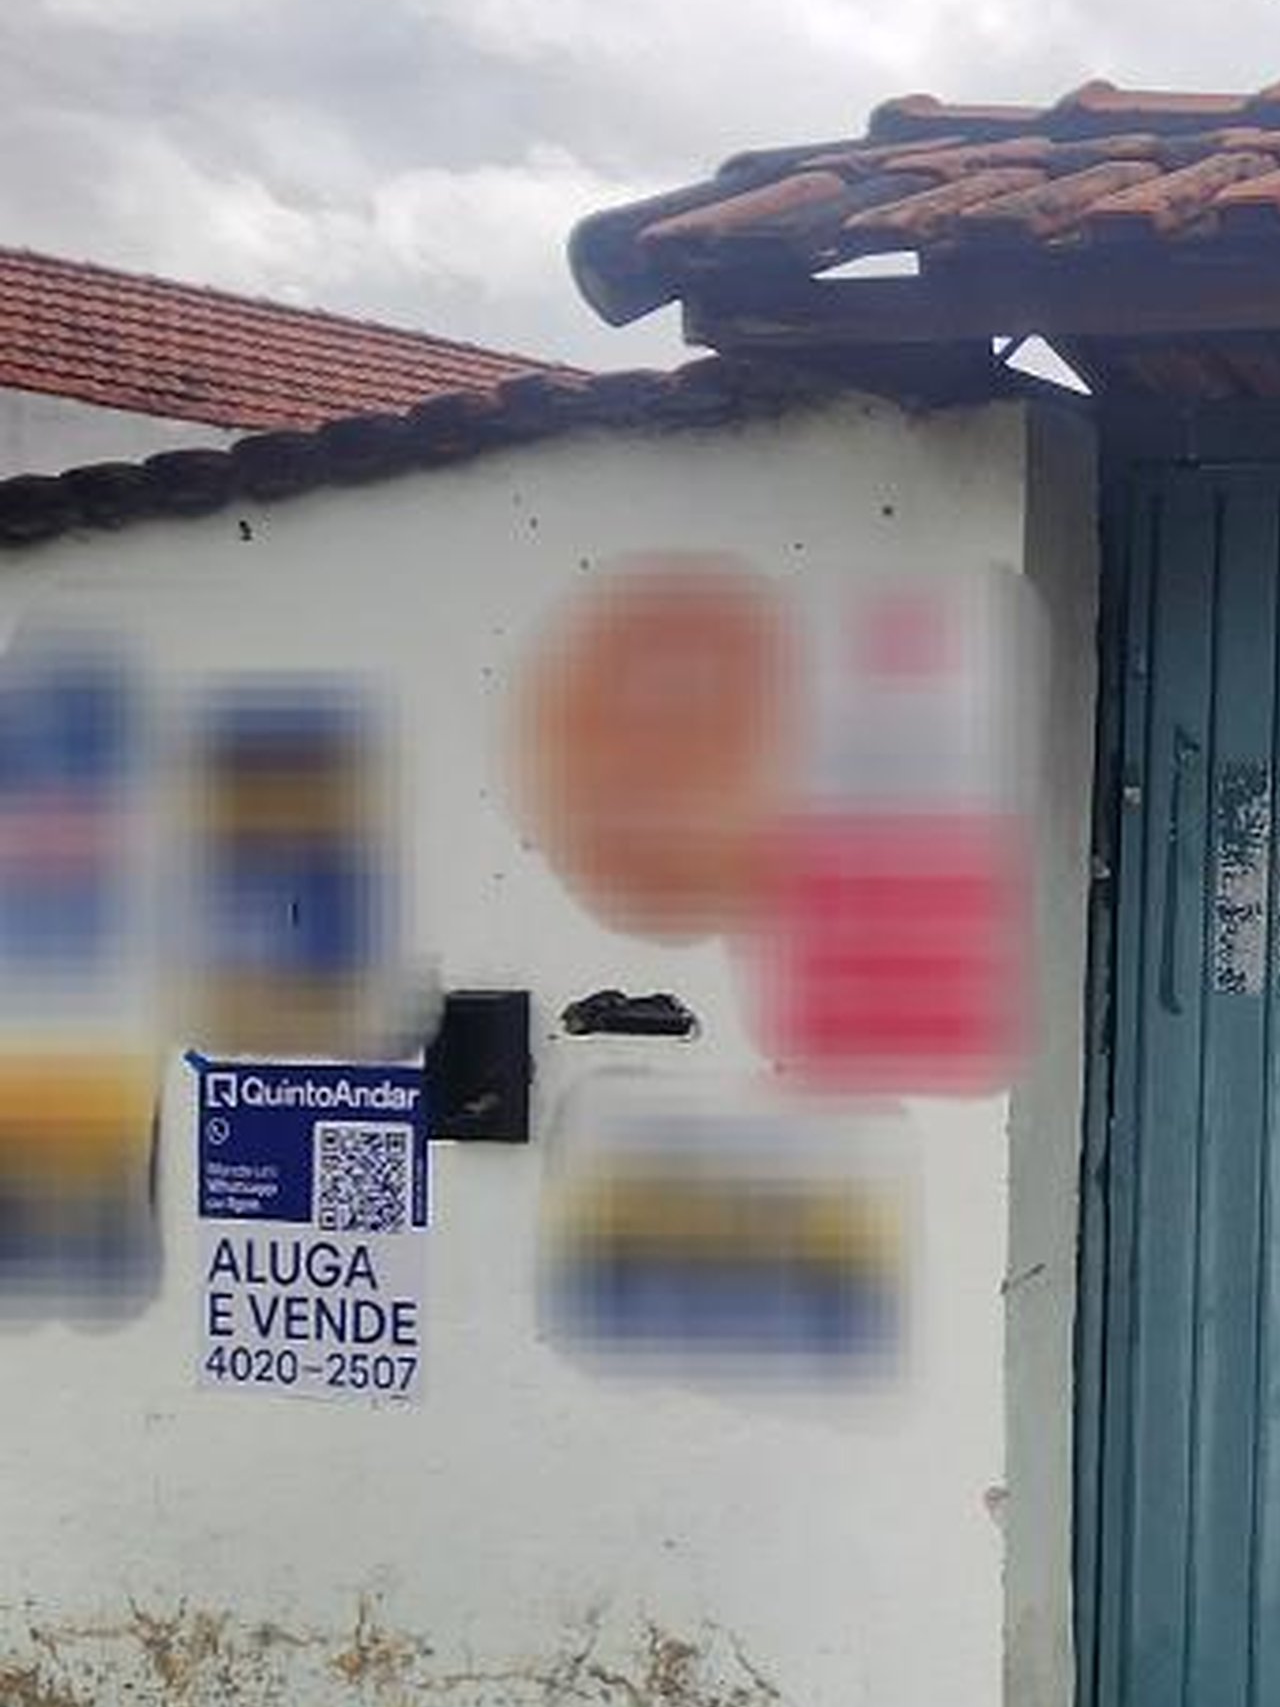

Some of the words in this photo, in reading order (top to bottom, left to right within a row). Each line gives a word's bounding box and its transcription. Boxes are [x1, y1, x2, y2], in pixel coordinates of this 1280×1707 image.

[240, 1075, 420, 1110] QuintoAndar
[208, 1237, 379, 1291] ALUGA
[209, 1292, 235, 1337] E
[248, 1294, 418, 1347] VENDE
[205, 1346, 418, 1391] 4020-2507
